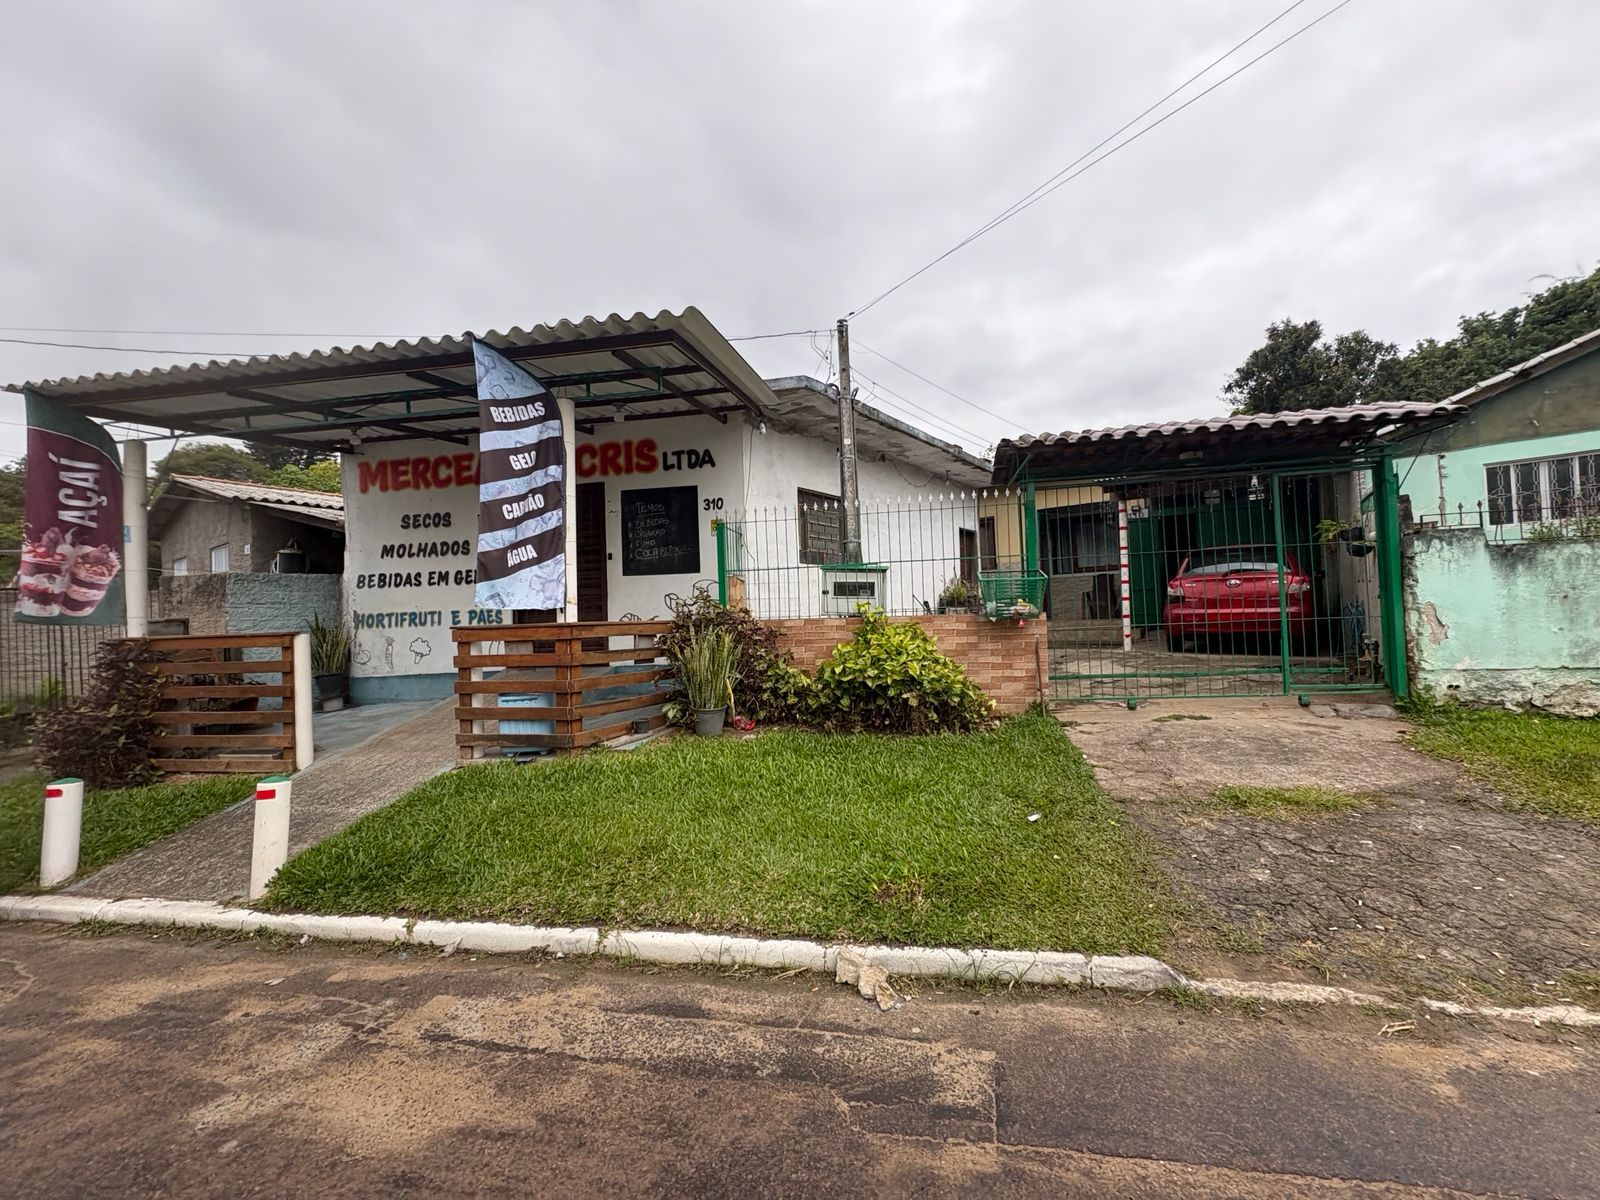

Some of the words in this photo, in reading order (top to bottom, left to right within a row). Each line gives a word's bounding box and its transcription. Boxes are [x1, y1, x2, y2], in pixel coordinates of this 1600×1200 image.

[489, 401, 546, 423] BEBIDAS
[357, 452, 480, 495] MERCE
[575, 437, 659, 478] CRIS
[662, 448, 716, 471] LTDA
[47, 452, 108, 529] AÇAÍ
[703, 497, 725, 511] 310
[400, 512, 452, 529] SECOS
[380, 539, 471, 559] MOLHADOS
[506, 543, 538, 568] ÁGUA
[356, 572, 422, 589] BEBIDAS
[427, 570, 449, 587] EM
[354, 610, 442, 630] HORTIFRUTI
[450, 609, 462, 625] E
